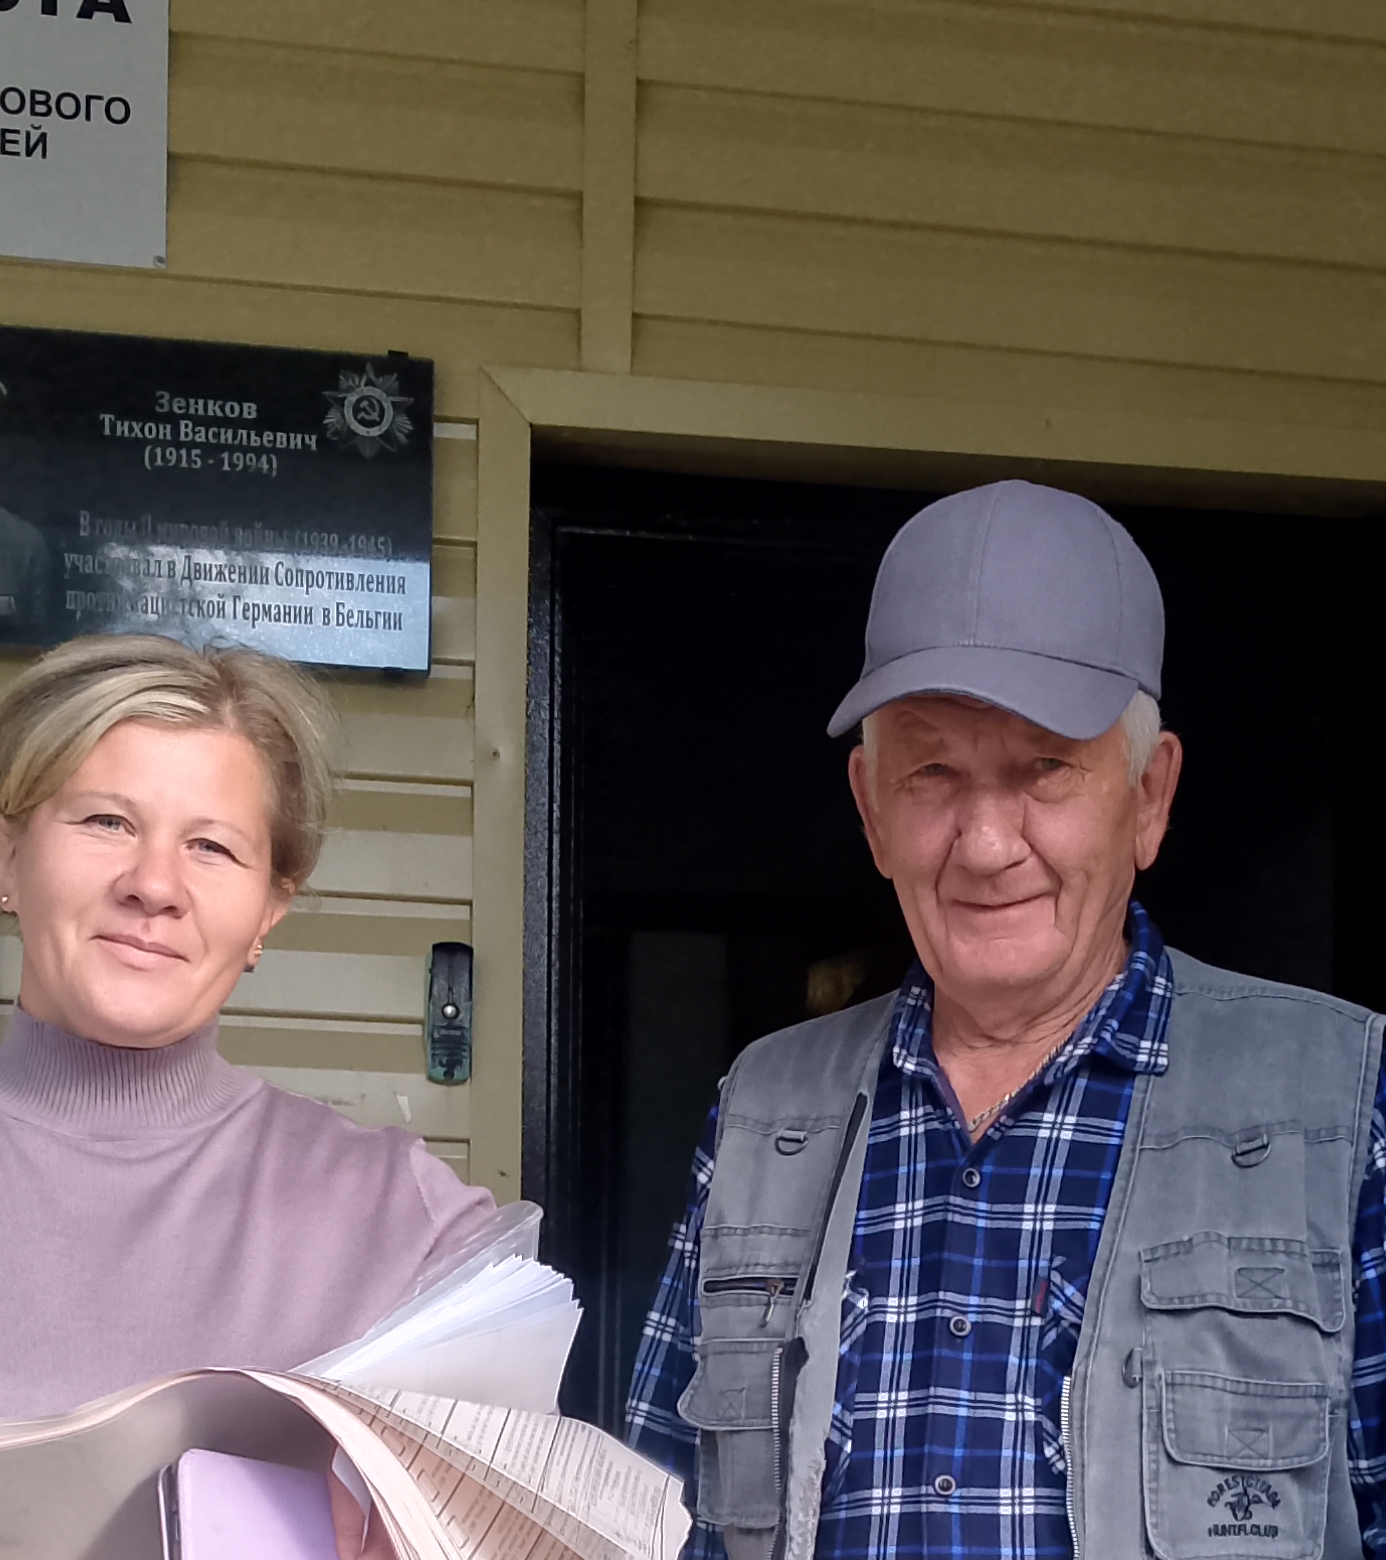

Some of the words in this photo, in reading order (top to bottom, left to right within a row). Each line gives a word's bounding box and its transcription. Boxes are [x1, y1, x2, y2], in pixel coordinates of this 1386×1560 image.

[155, 391, 258, 420] Зенков
[100, 413, 171, 441] Тихон
[179, 420, 317, 451] Васильевич
[144, 445, 201, 470] (1915
[221, 451, 278, 477] 1994)
[167, 559, 177, 578] в
[181, 554, 270, 587] Движении
[274, 560, 407, 595] Сопротивления
[231, 595, 313, 630] Германии
[322, 609, 331, 626] в
[334, 601, 403, 631] Бельгии
